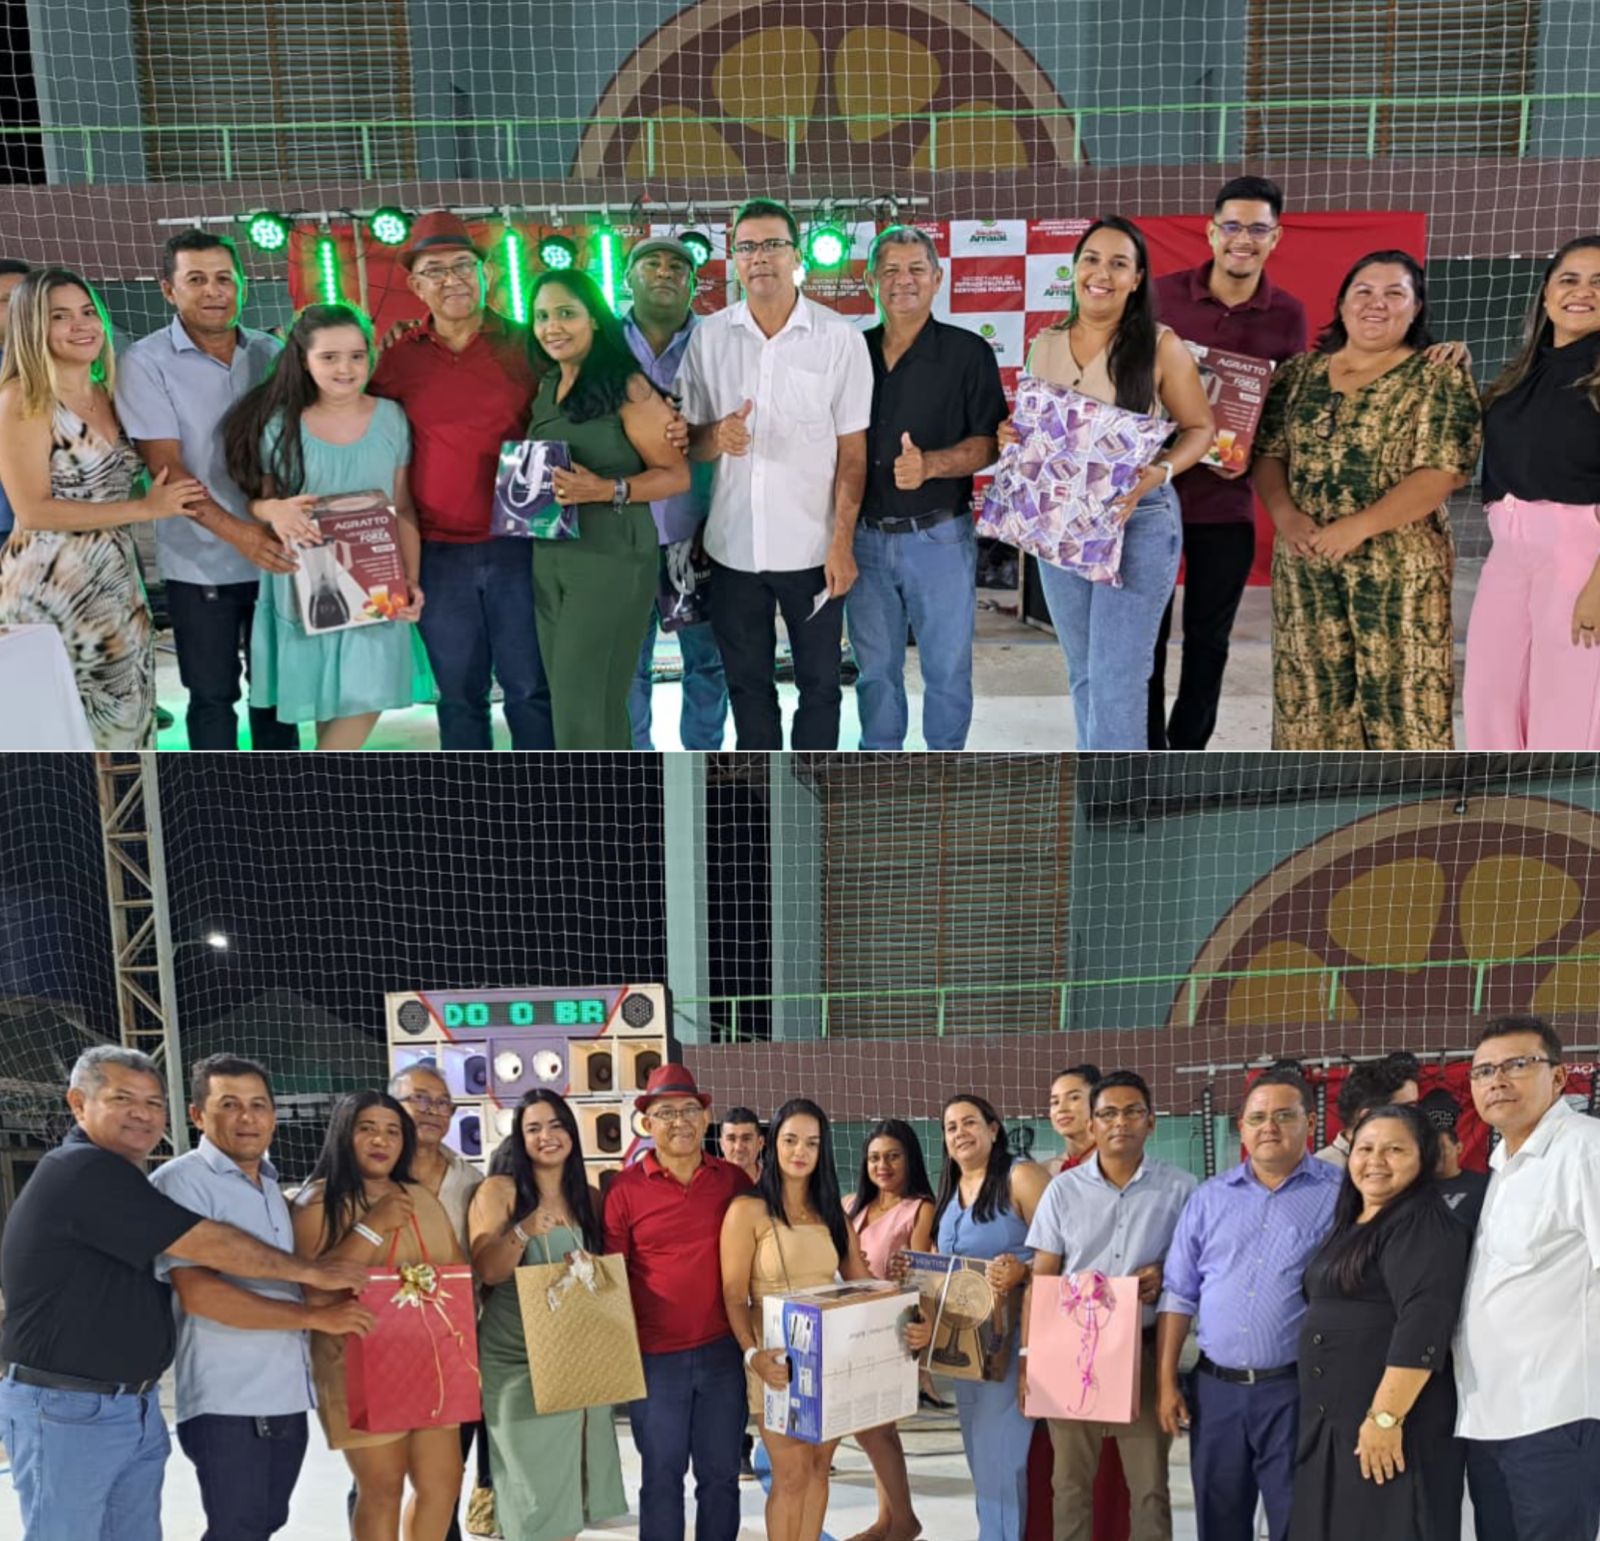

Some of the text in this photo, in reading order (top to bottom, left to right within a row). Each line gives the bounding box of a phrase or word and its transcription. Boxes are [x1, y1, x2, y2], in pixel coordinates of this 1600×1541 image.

[1216, 357, 1268, 376] AGRATTO
[333, 515, 389, 531] AGRATTO
[443, 999, 604, 1028] DO O BR
